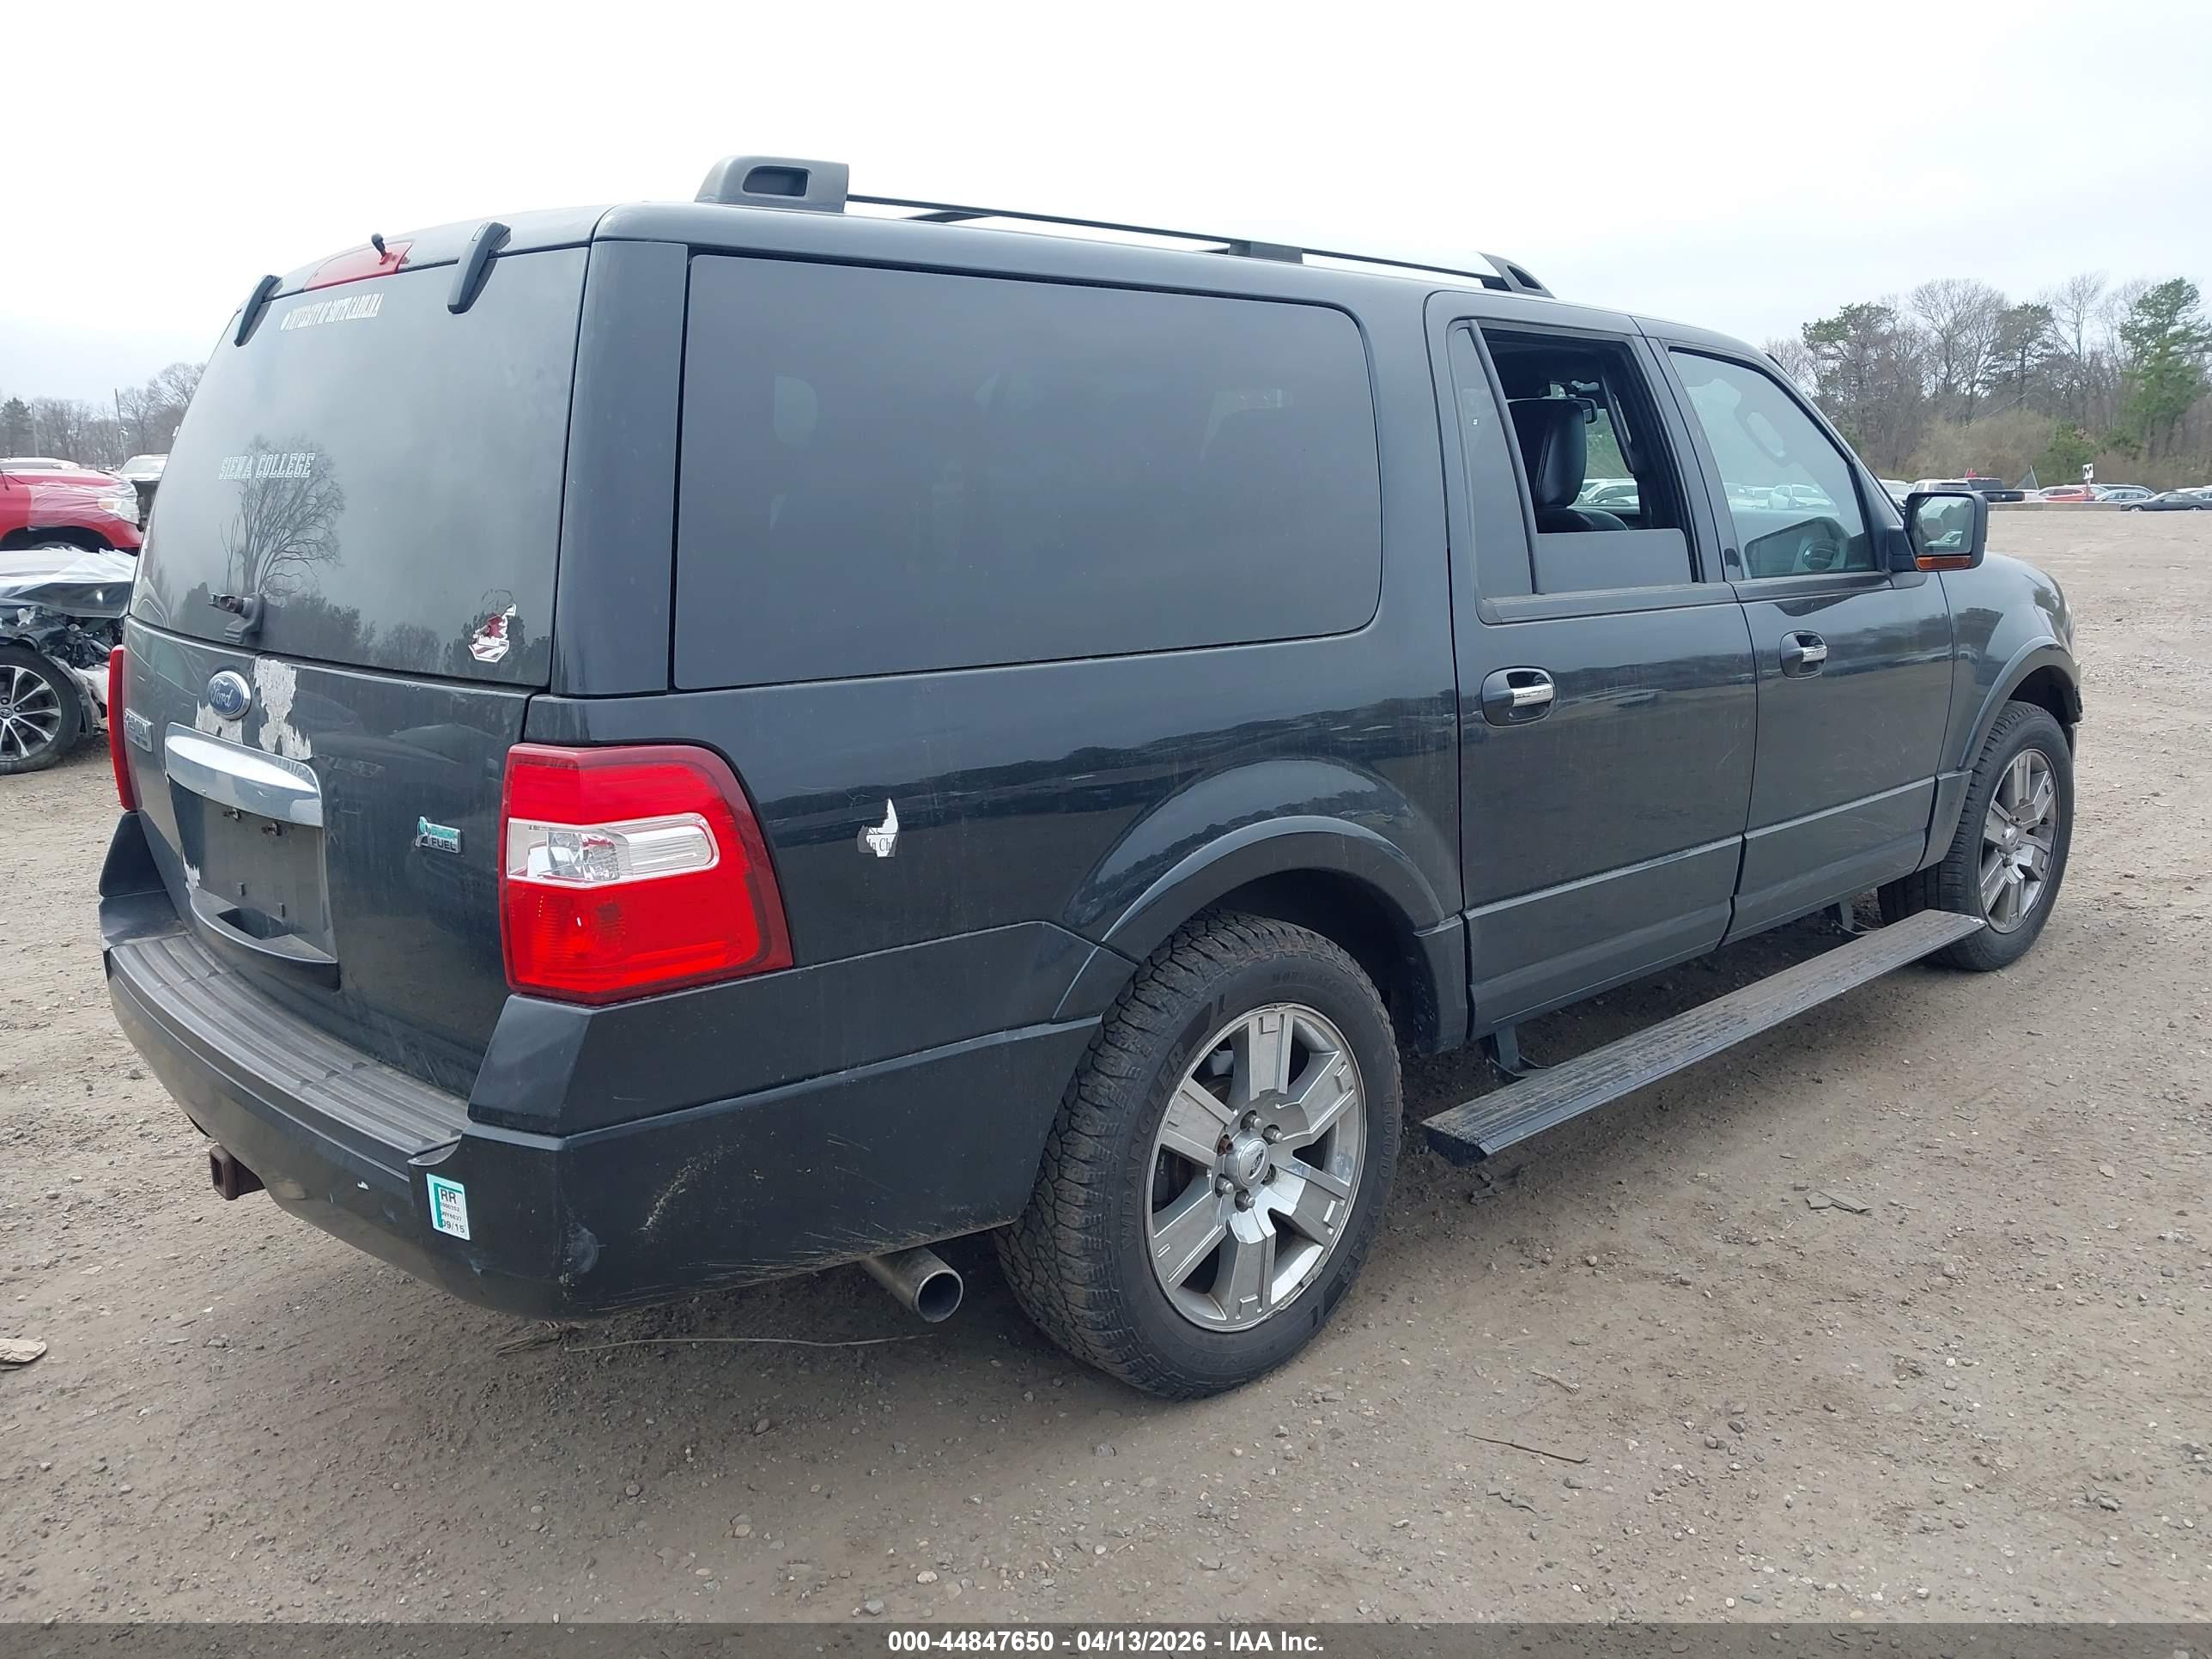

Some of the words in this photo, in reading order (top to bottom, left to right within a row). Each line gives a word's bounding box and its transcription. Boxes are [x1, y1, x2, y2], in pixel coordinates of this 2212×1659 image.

[218, 455, 253, 480] SIENA
[256, 453, 316, 478] COLLEGE
[211, 678, 234, 708] Ford
[431, 837, 457, 852] FUEL
[1119, 1042, 1187, 1251] WRANGLER
[440, 1188, 457, 1205] RR
[441, 1219, 465, 1234] 09/15
